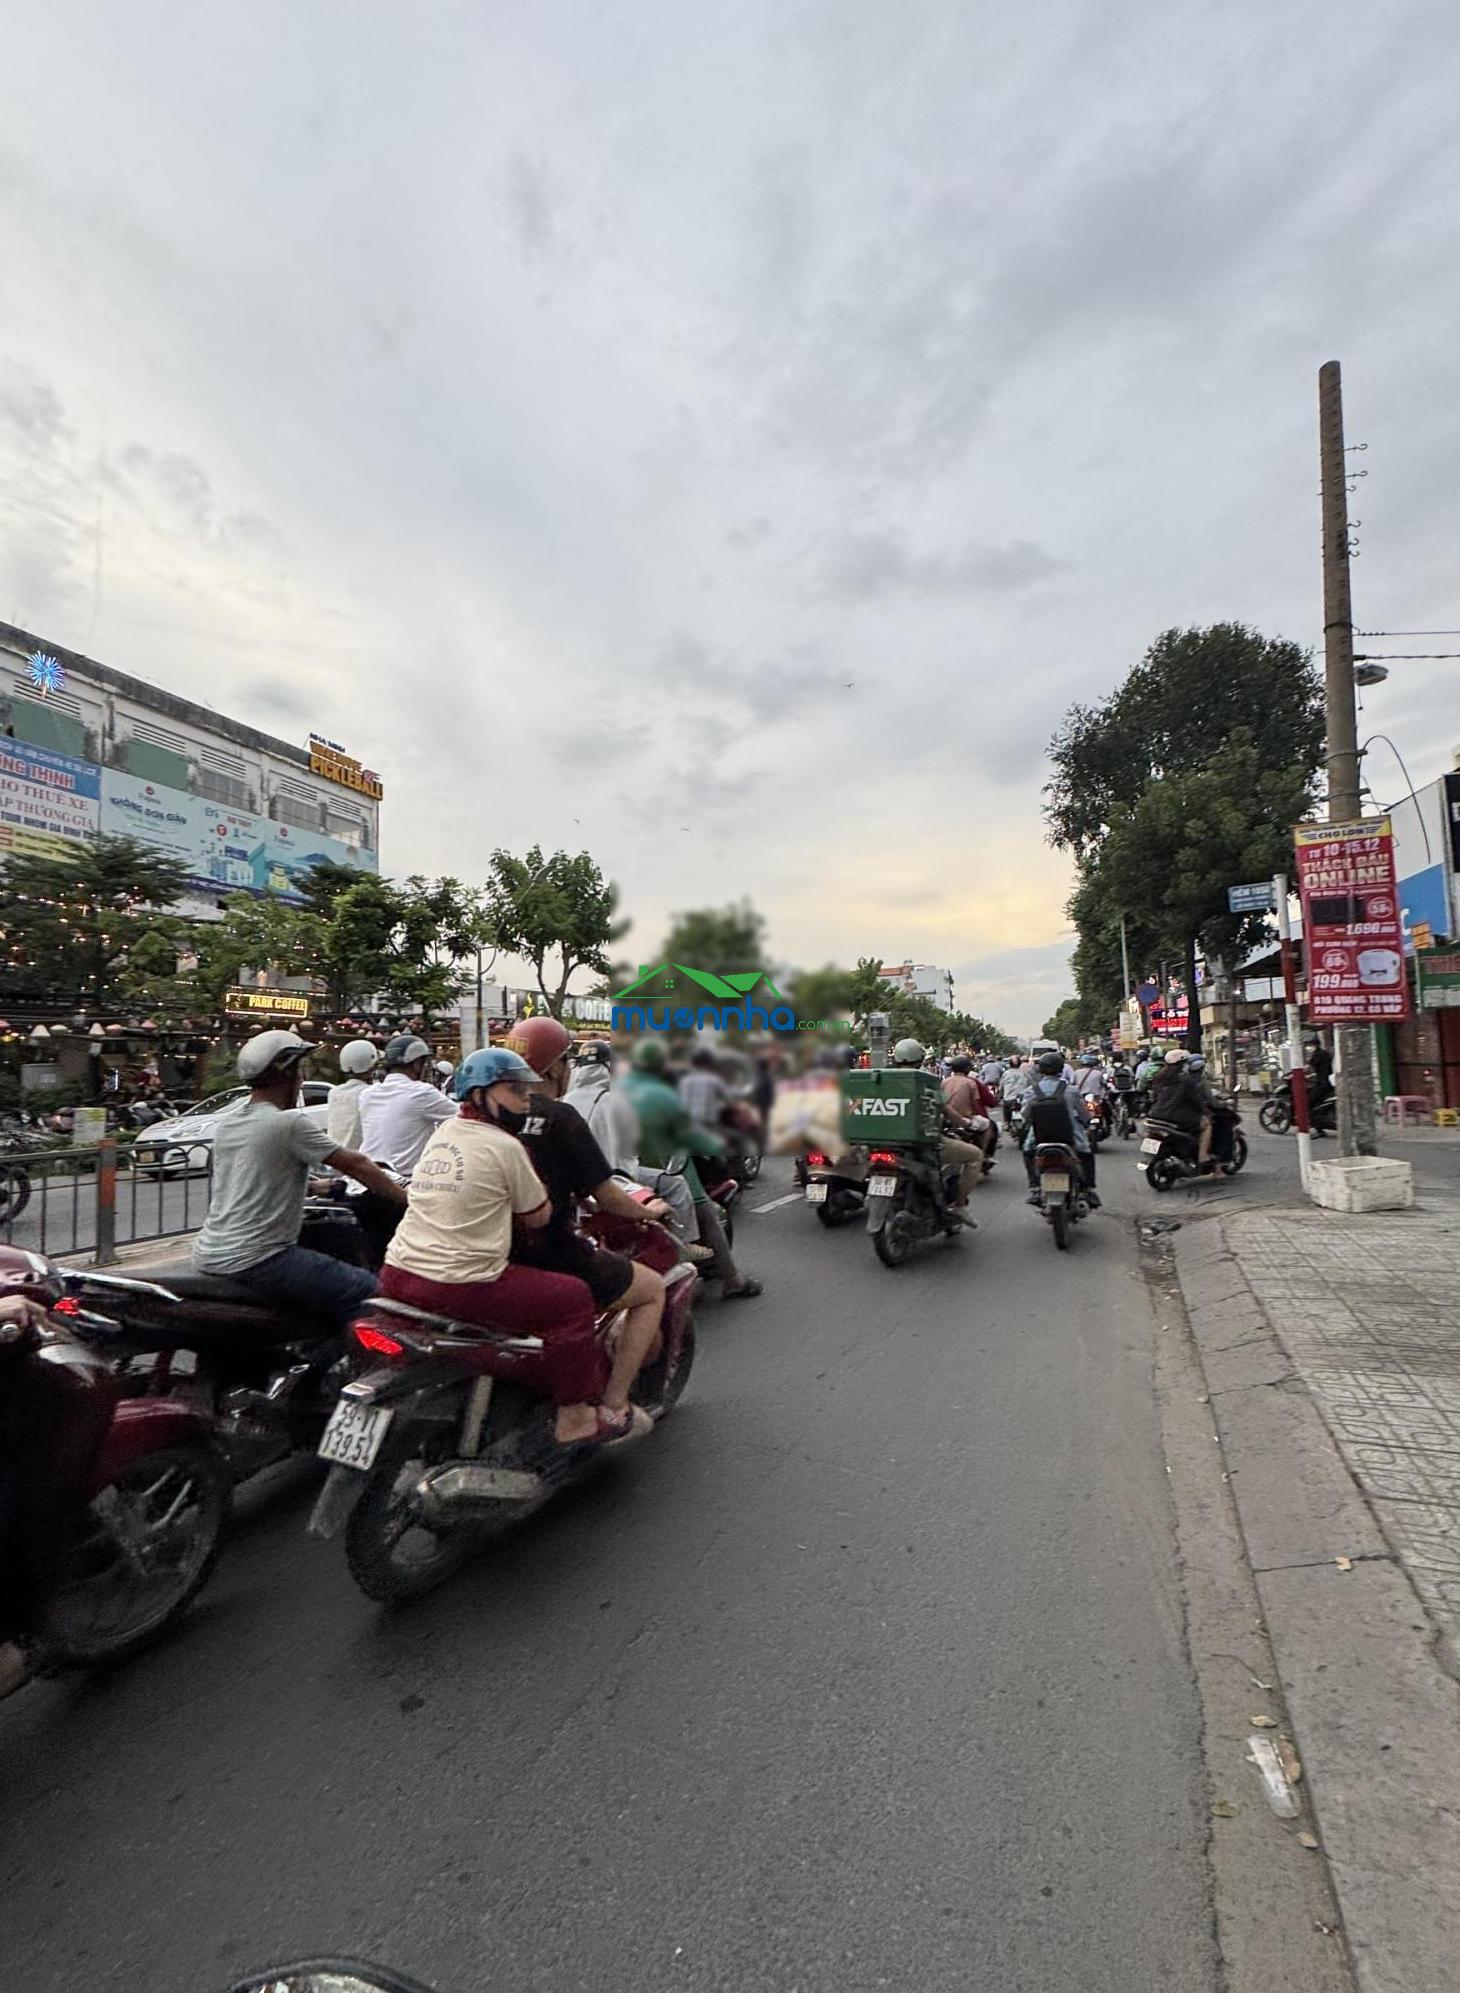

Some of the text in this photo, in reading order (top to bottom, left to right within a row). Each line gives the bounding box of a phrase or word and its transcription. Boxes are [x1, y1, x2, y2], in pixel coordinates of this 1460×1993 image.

[1303, 865, 1391, 889] ONLINE
[249, 996, 305, 1011] PARK COFFEE
